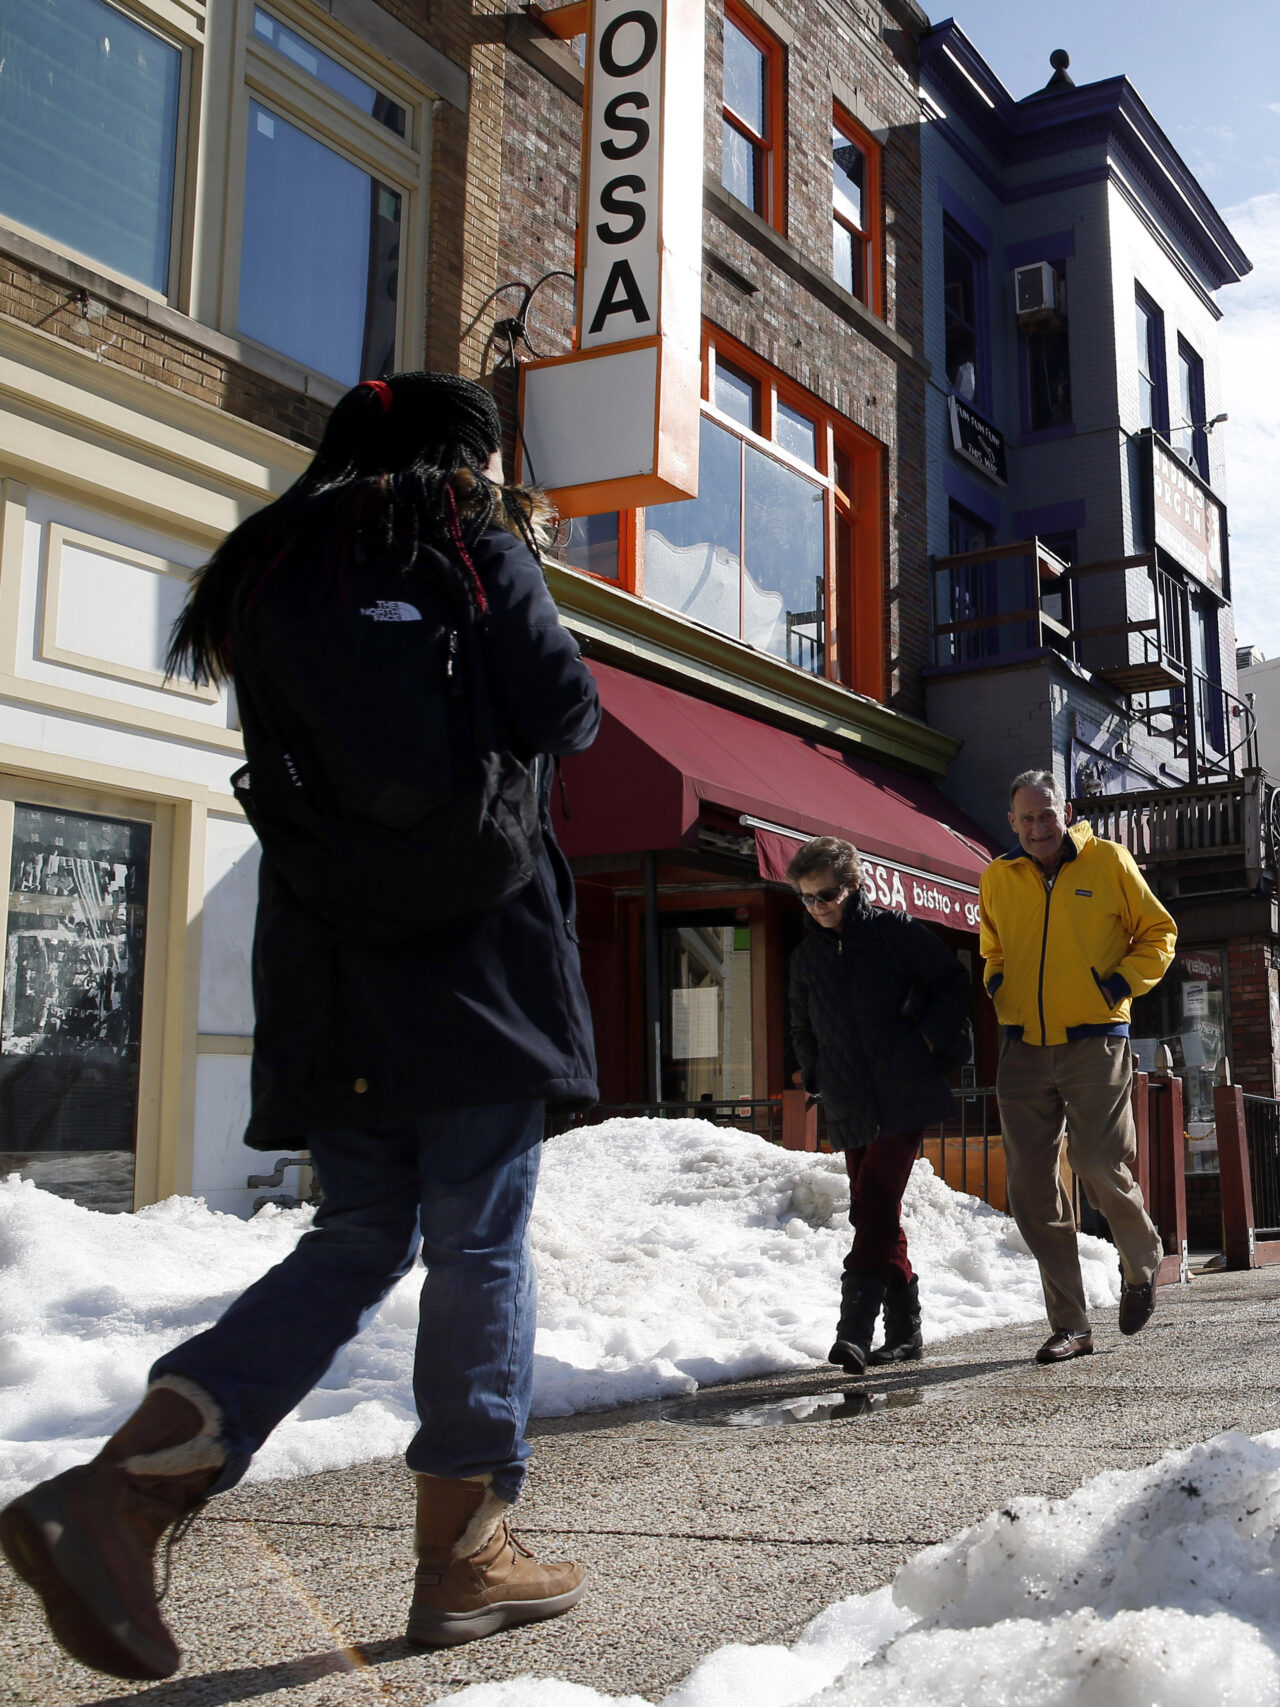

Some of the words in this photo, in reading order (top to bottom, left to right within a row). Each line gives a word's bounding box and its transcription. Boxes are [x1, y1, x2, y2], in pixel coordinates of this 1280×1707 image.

[588, 0, 658, 334] OSSA
[1154, 476, 1201, 534] ORGAN
[376, 600, 398, 609] THE
[913, 882, 951, 914] bistro
